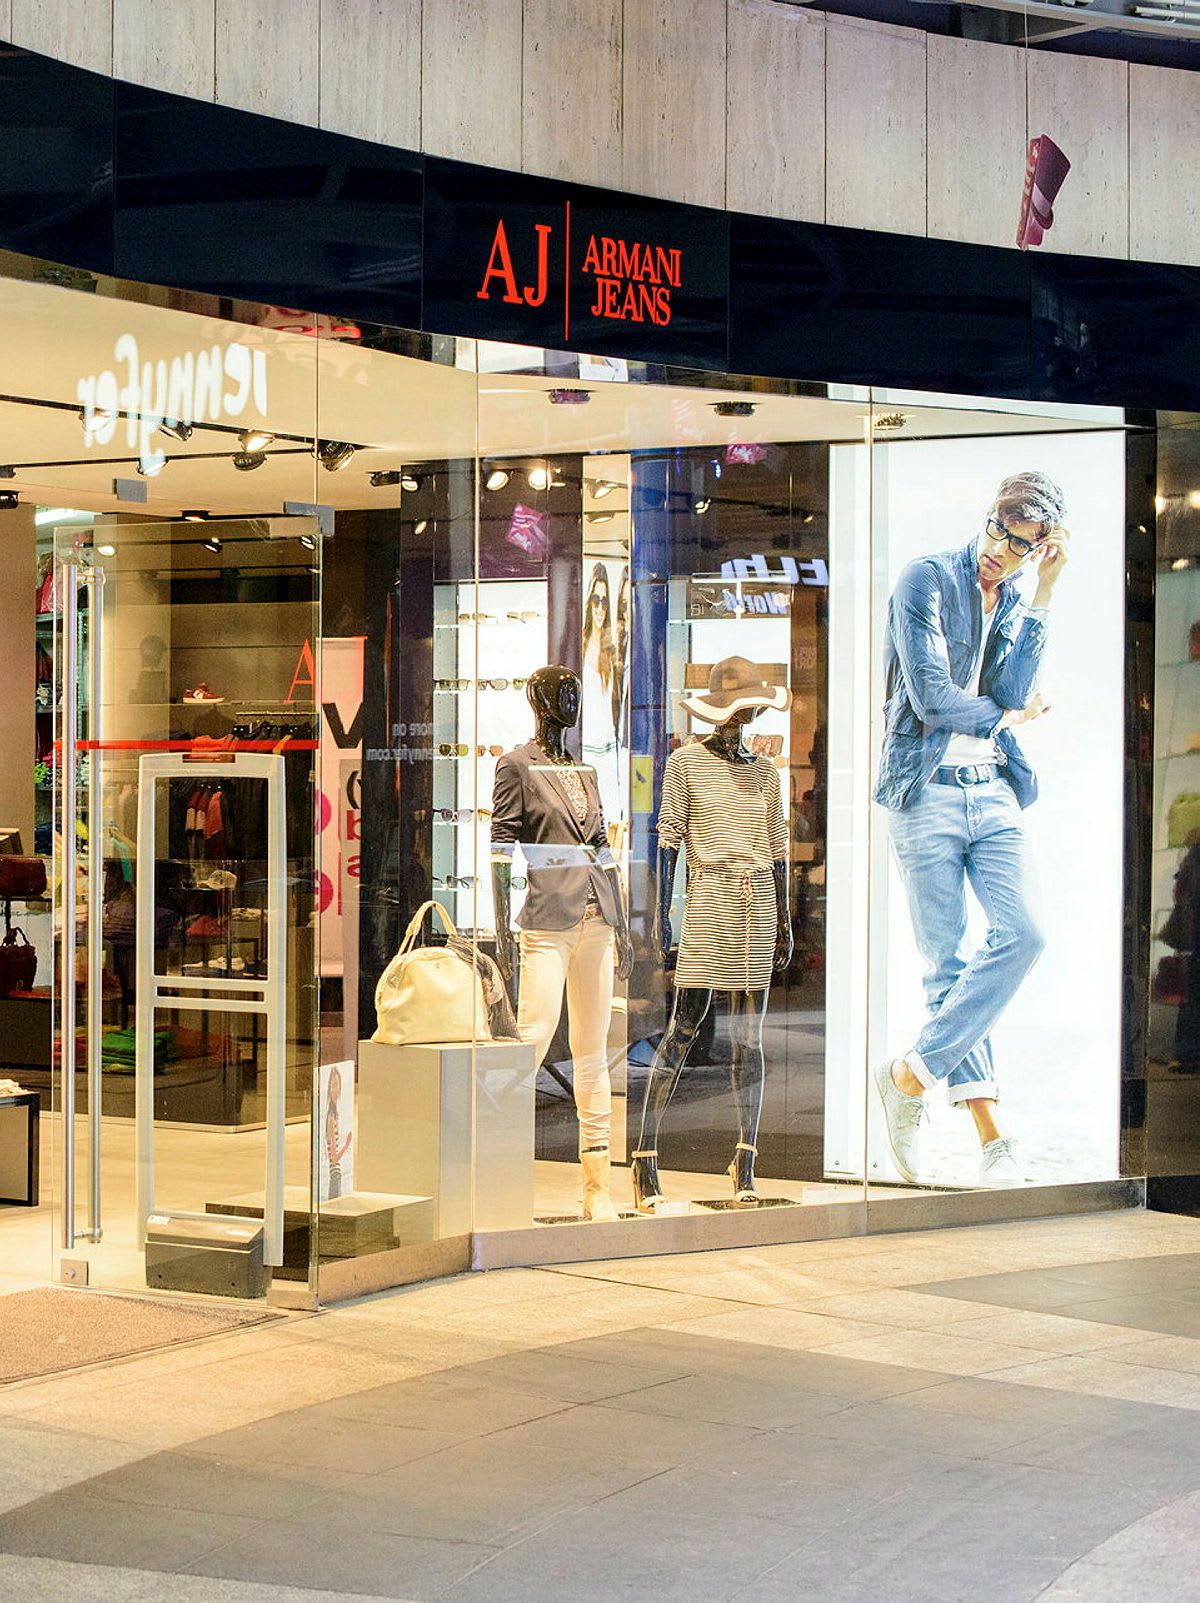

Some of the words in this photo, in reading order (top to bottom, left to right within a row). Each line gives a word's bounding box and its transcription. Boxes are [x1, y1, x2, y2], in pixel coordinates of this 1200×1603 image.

[476, 219, 552, 307] AJ
[582, 233, 682, 288] ARMANI
[590, 277, 672, 327] JEANS
